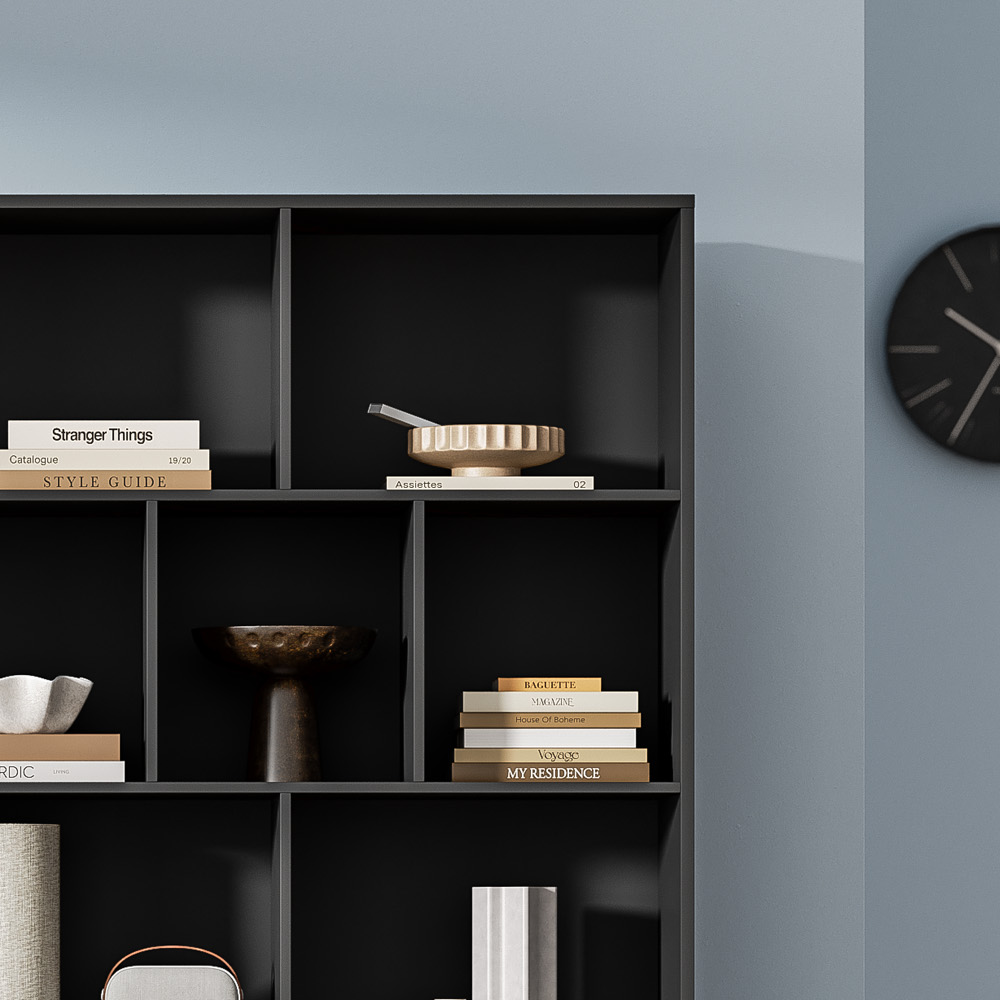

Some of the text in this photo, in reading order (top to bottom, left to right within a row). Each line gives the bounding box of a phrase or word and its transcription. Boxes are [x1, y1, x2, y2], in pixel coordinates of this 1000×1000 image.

[52, 427, 153, 444] Stranger Things
[9, 454, 192, 466] Catalogue 19/20
[43, 476, 167, 488] STYLE GUIDE
[395, 481, 586, 489] Assiettes 02
[524, 681, 577, 689] BAGUETTE
[531, 697, 574, 707] MAGAZINE
[515, 716, 586, 724] House Of Boheme
[538, 749, 580, 762] Voyage
[506, 767, 600, 779] MY RESIDENCE
